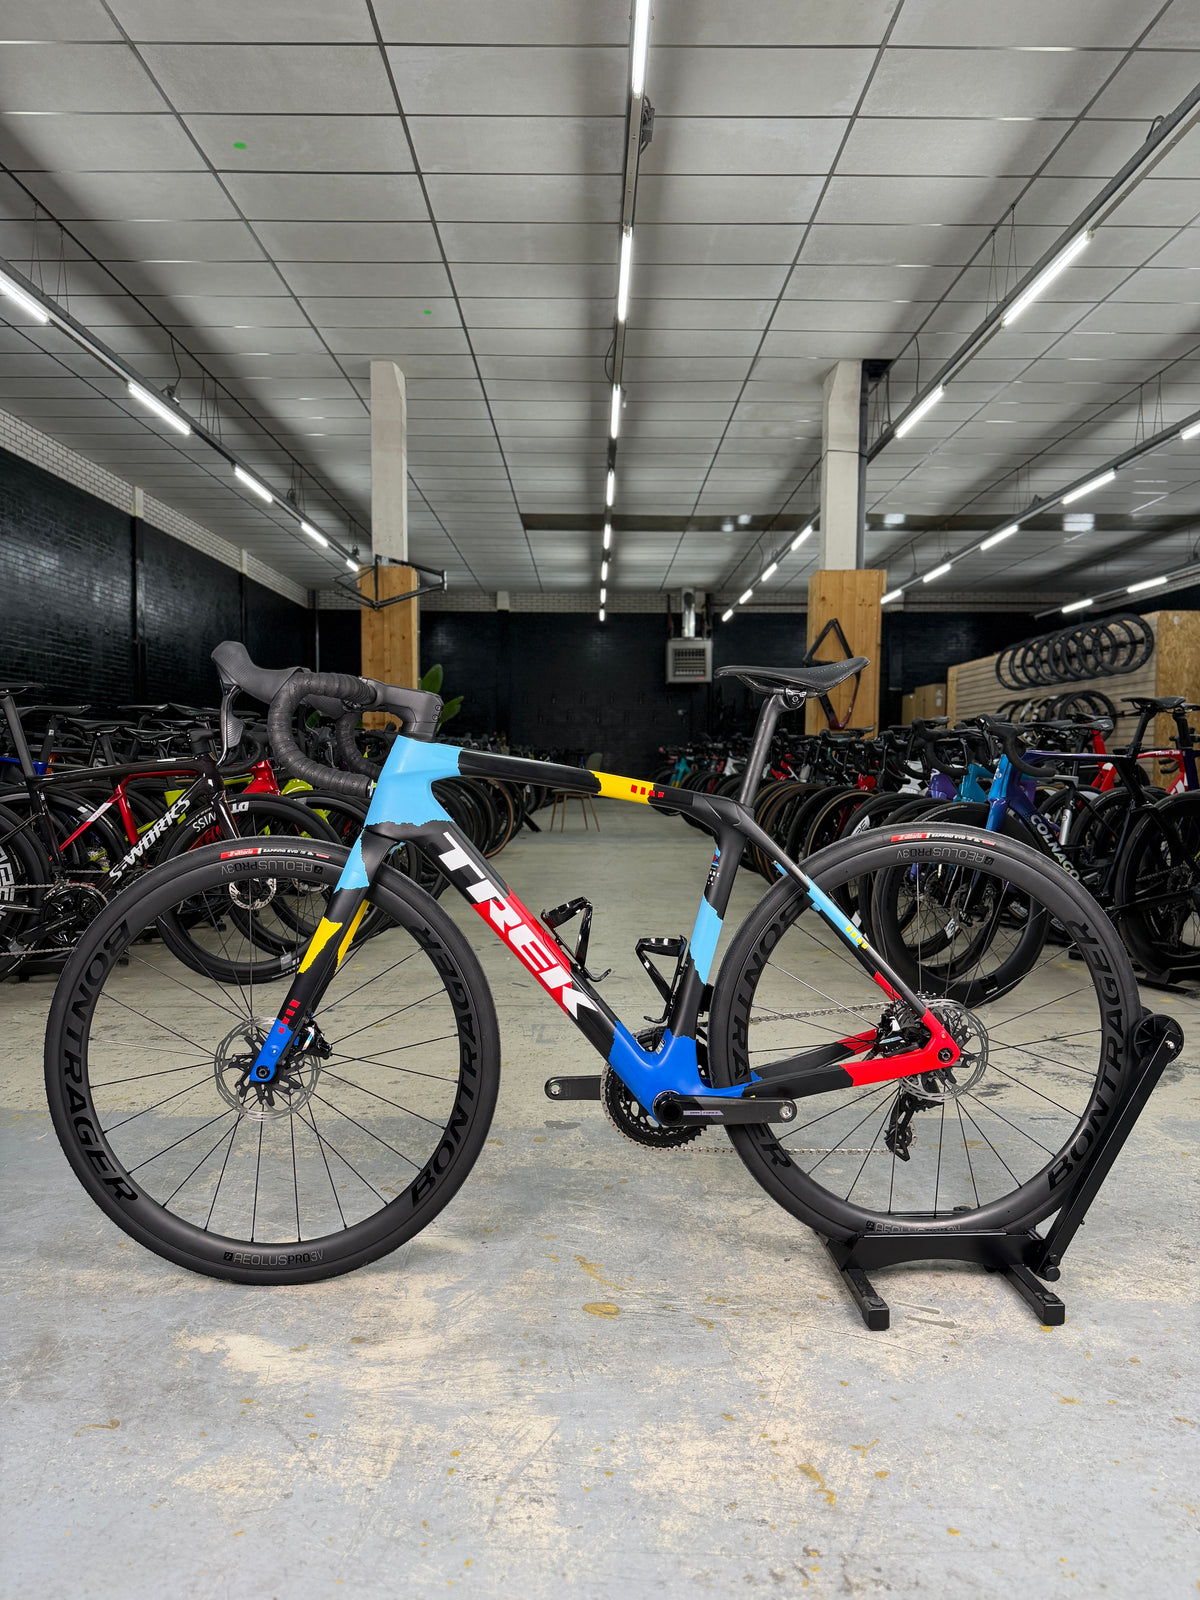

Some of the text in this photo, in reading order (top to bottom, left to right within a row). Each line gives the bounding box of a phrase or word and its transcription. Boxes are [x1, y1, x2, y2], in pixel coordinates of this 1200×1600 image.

[109, 796, 190, 884] S-WORKS
[230, 801, 249, 813] DT
[1031, 814, 1081, 880] COLNAGO
[438, 831, 598, 1019] TREK
[64, 919, 138, 1201] BONTRAGER
[408, 924, 477, 1207] BONTRAGER
[1047, 920, 1124, 1191] BONTRAGER
